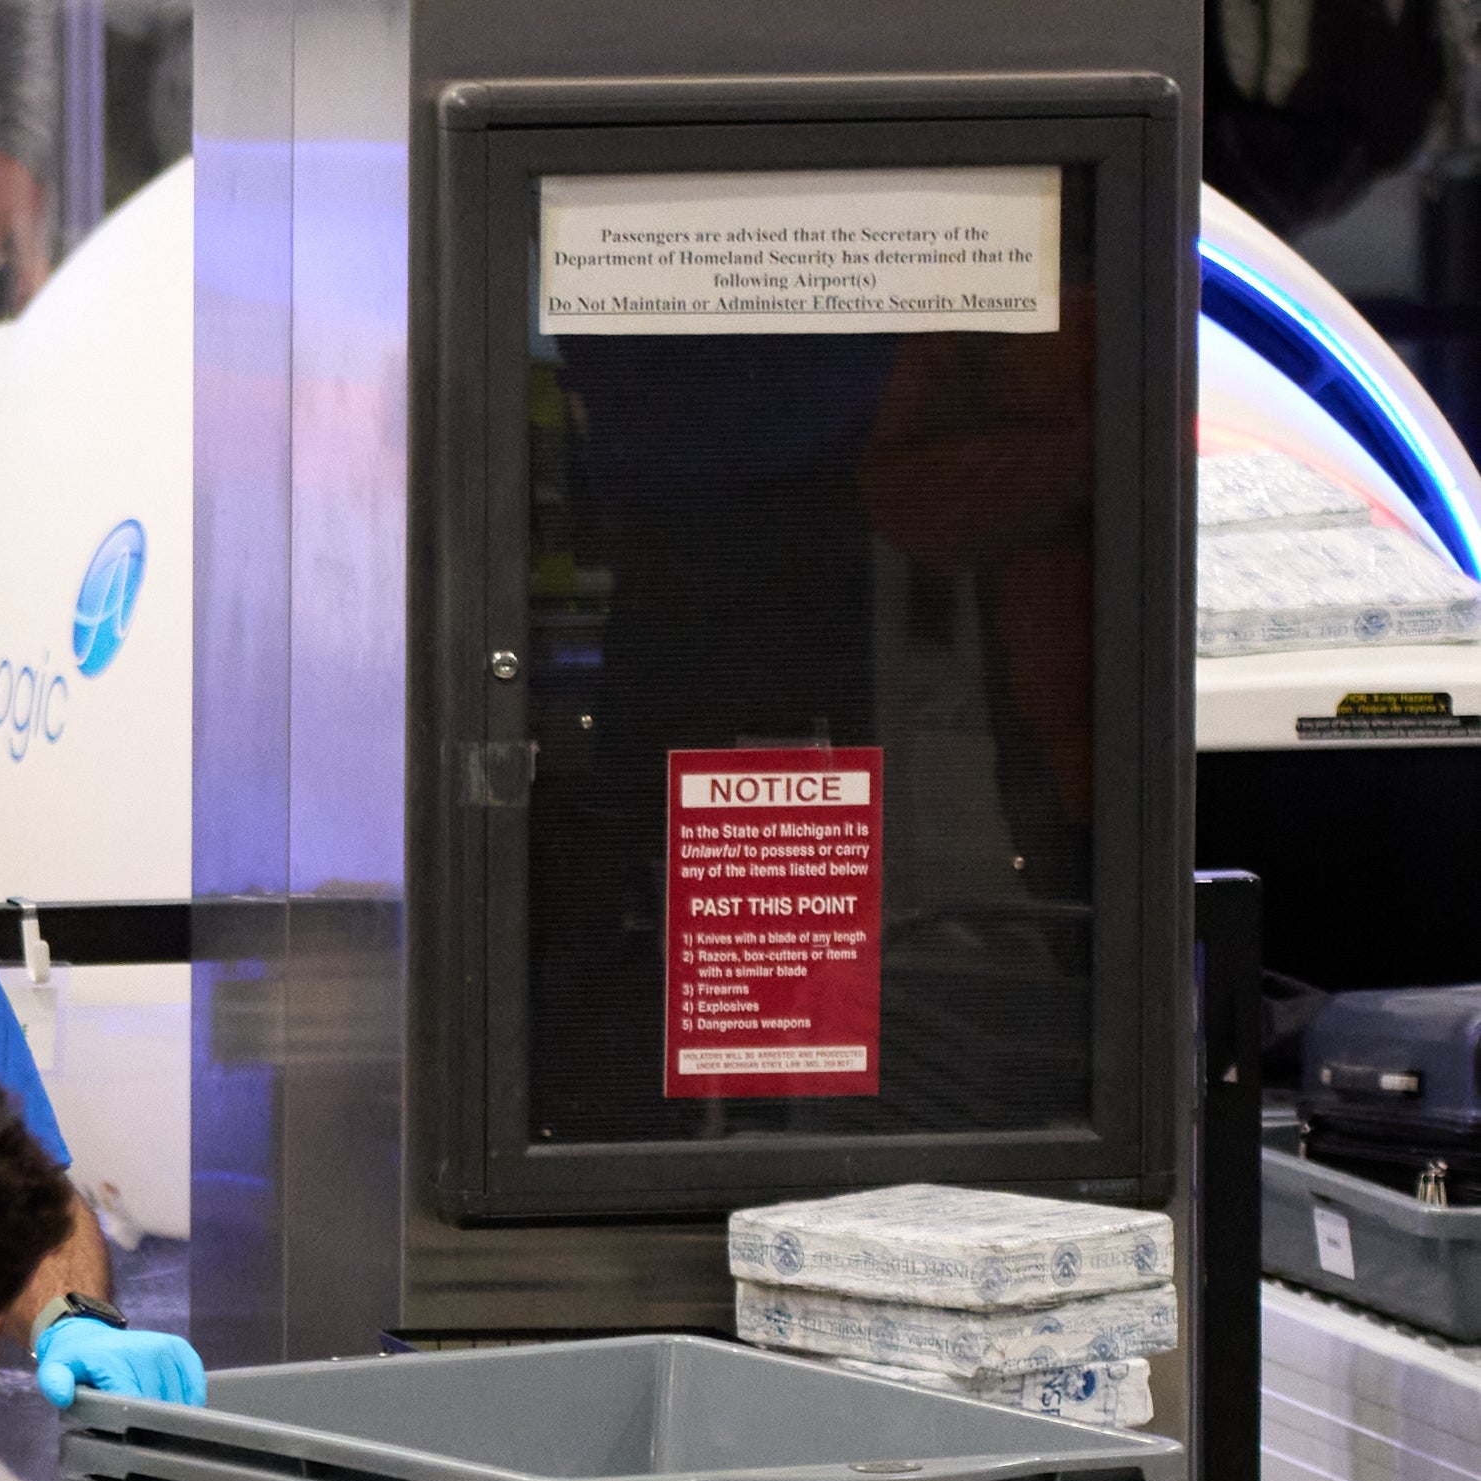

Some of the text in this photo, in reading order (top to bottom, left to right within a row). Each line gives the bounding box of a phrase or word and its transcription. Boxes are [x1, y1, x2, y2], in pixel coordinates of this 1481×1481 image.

[601, 228, 989, 245] Passengers are advised that the Secretary of the
[555, 249, 1032, 269] Department of Homeland Security has determined that the
[714, 273, 877, 290] following Airport(s)
[548, 294, 1037, 311] Do Not Maintain or Administer Effective Security Measures
[710, 777, 841, 803] NOTICE
[681, 823, 868, 840] In the State of Michigan it is
[682, 845, 869, 860] Unlawful to possess or carry
[682, 862, 868, 880] any of the items listed below
[692, 896, 857, 916] PAST THIS POINT
[683, 931, 866, 946] 1) Knives with a blade of any length
[683, 949, 857, 964] 2) Razors, box-cutters or items
[699, 965, 807, 977] with a similar blade
[683, 983, 749, 997] 3) Firearms
[683, 1001, 759, 1015] 4) Explosives
[683, 1018, 811, 1032] 5) Dangerous weapons
